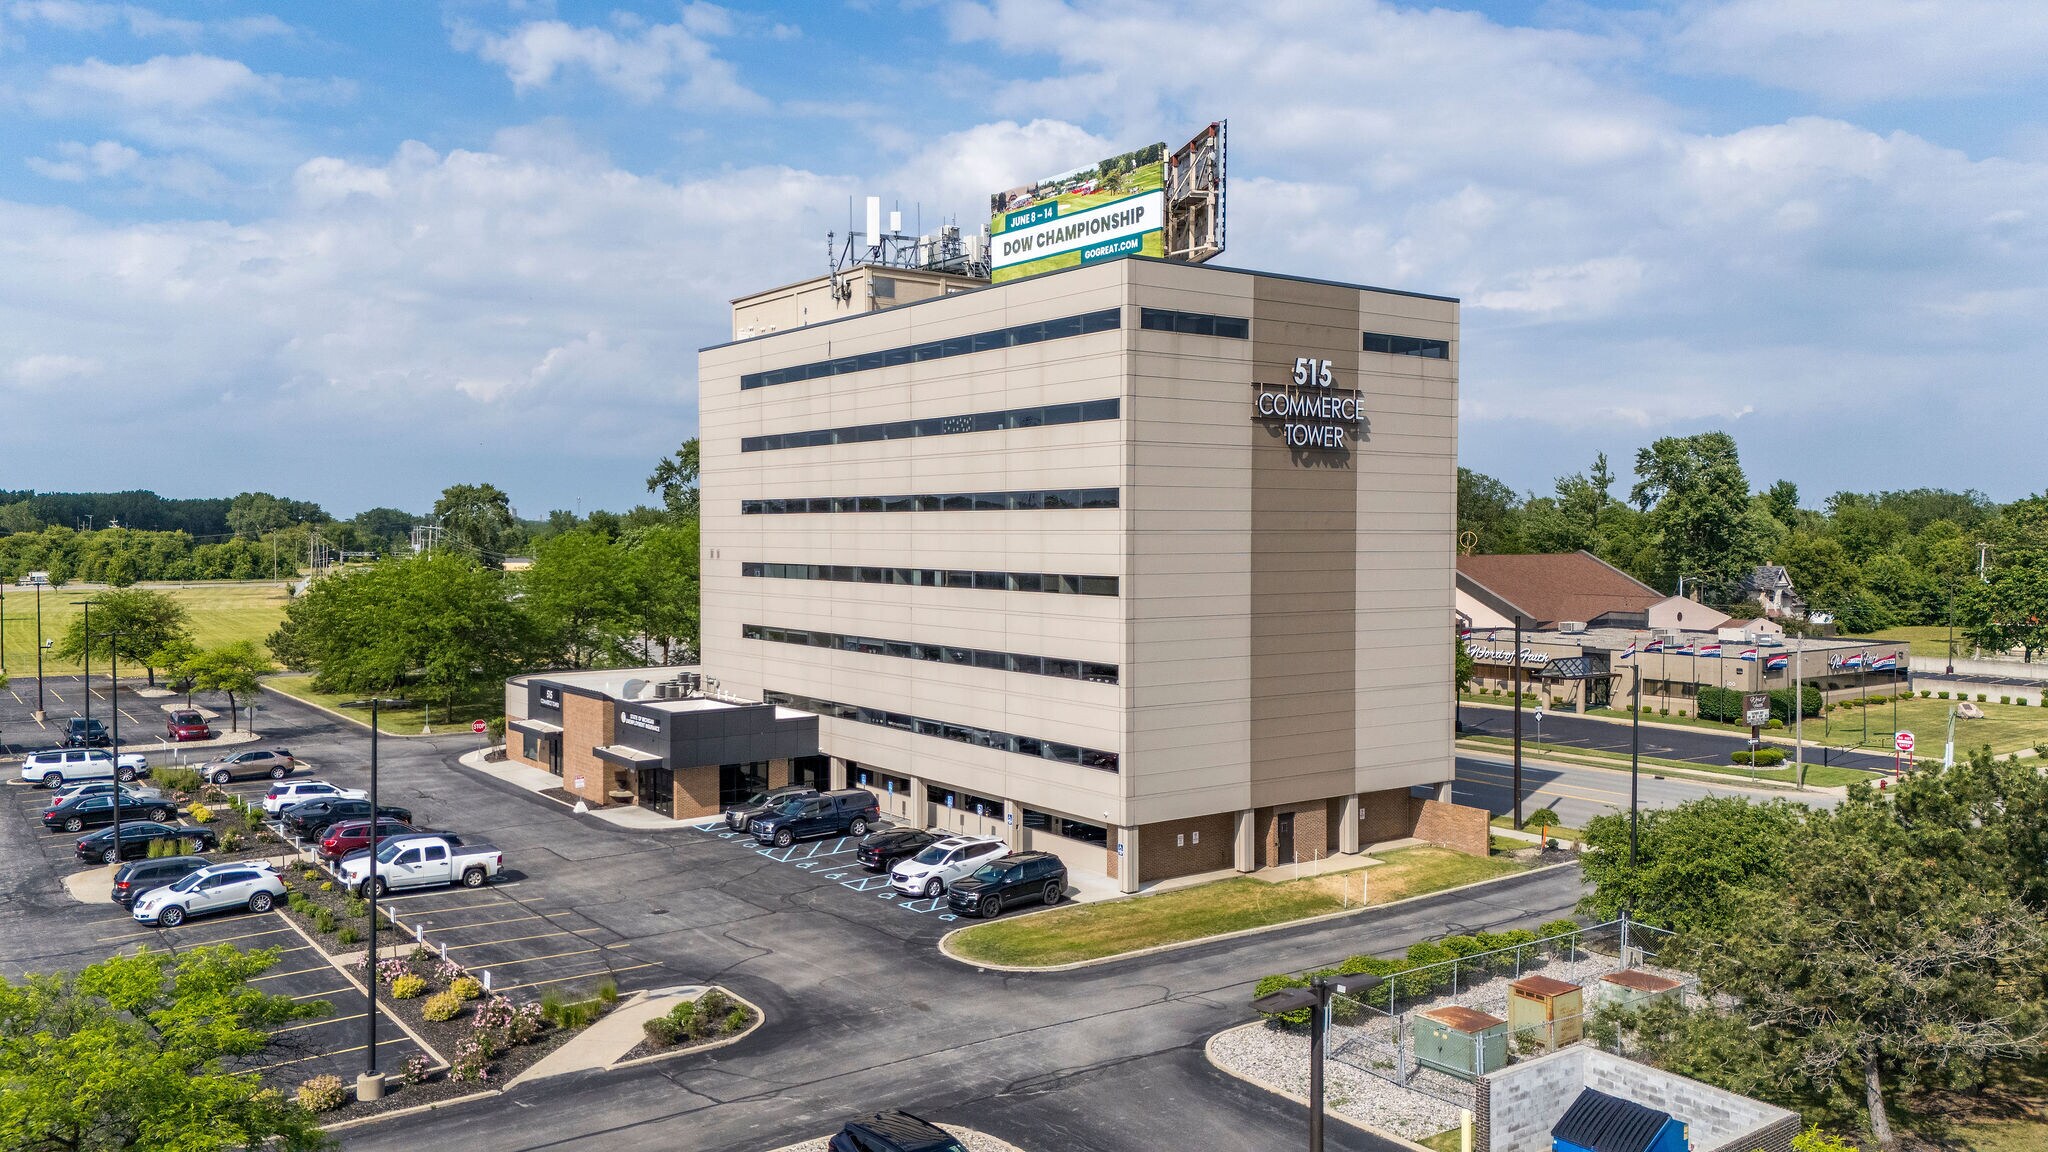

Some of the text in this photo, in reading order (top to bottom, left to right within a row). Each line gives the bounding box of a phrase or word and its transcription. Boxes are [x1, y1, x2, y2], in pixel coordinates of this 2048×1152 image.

[1010, 212, 1030, 228] JUNE
[1031, 210, 1036, 223] 8
[1044, 207, 1053, 220] 14
[1003, 206, 1145, 257] DOW CHAMPIONSHIP
[1084, 238, 1138, 259] GOGREAT.COM
[1294, 357, 1332, 387] 515
[1259, 392, 1365, 420] COMMERCE
[1285, 423, 1344, 448] TOWER
[1466, 643, 1549, 663] Word of Faith
